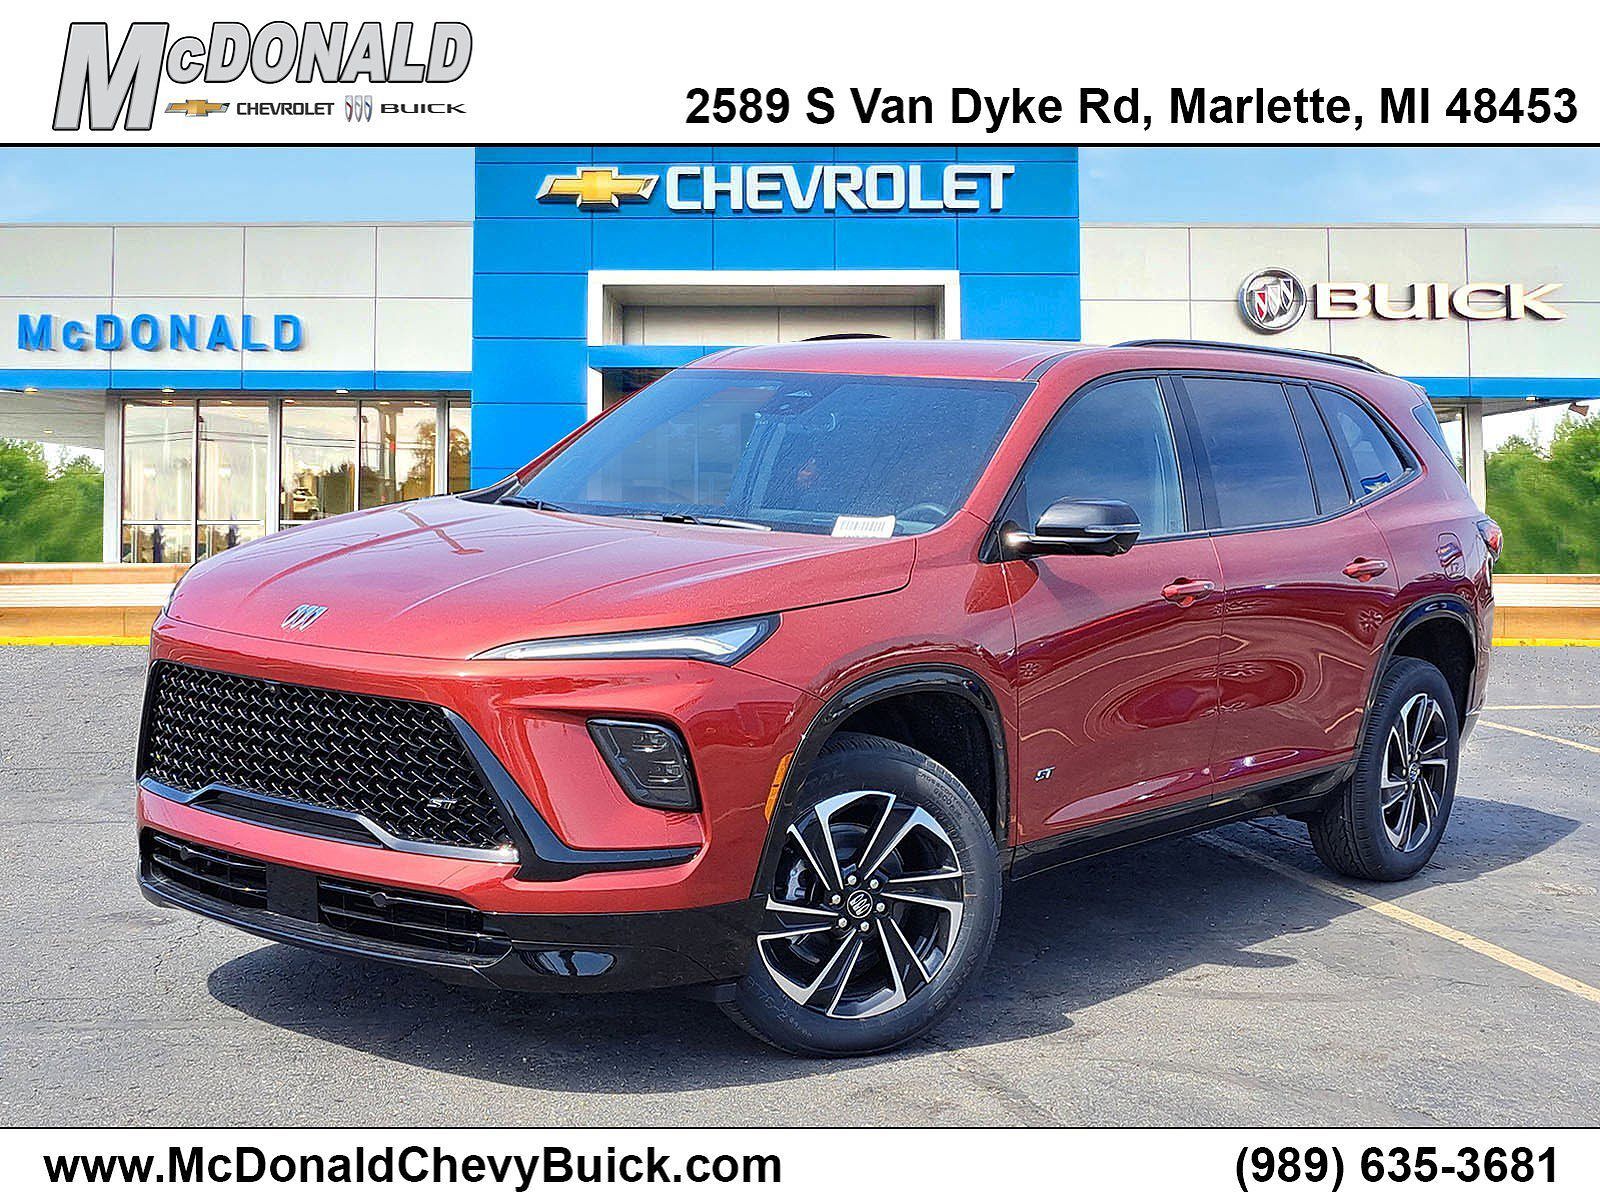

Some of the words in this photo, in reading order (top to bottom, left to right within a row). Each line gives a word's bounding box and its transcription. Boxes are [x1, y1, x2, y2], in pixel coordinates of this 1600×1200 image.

[666, 164, 1015, 211] CHEVROLET
[1314, 281, 1566, 320] BUICK
[18, 314, 304, 351] McDONALD
